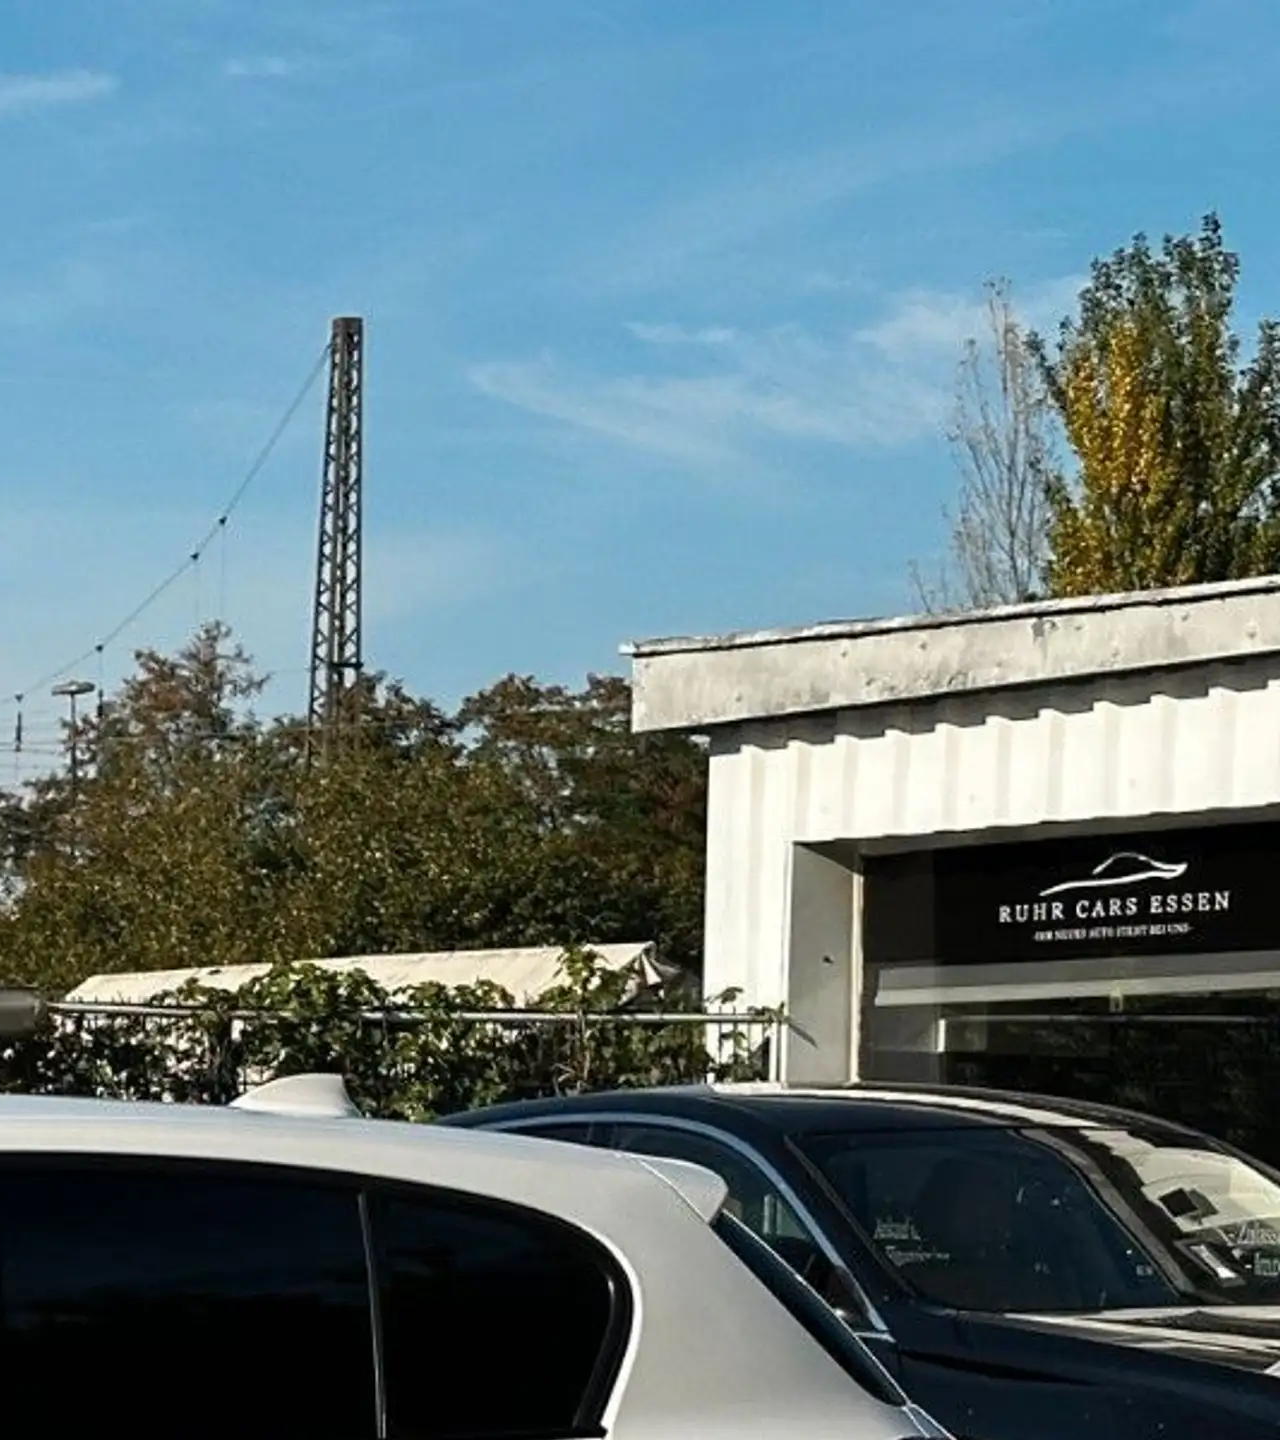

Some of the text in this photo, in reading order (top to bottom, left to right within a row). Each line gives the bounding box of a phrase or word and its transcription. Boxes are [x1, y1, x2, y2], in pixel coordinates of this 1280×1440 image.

[998, 890, 1230, 923] RUHR CARS ESSEN
